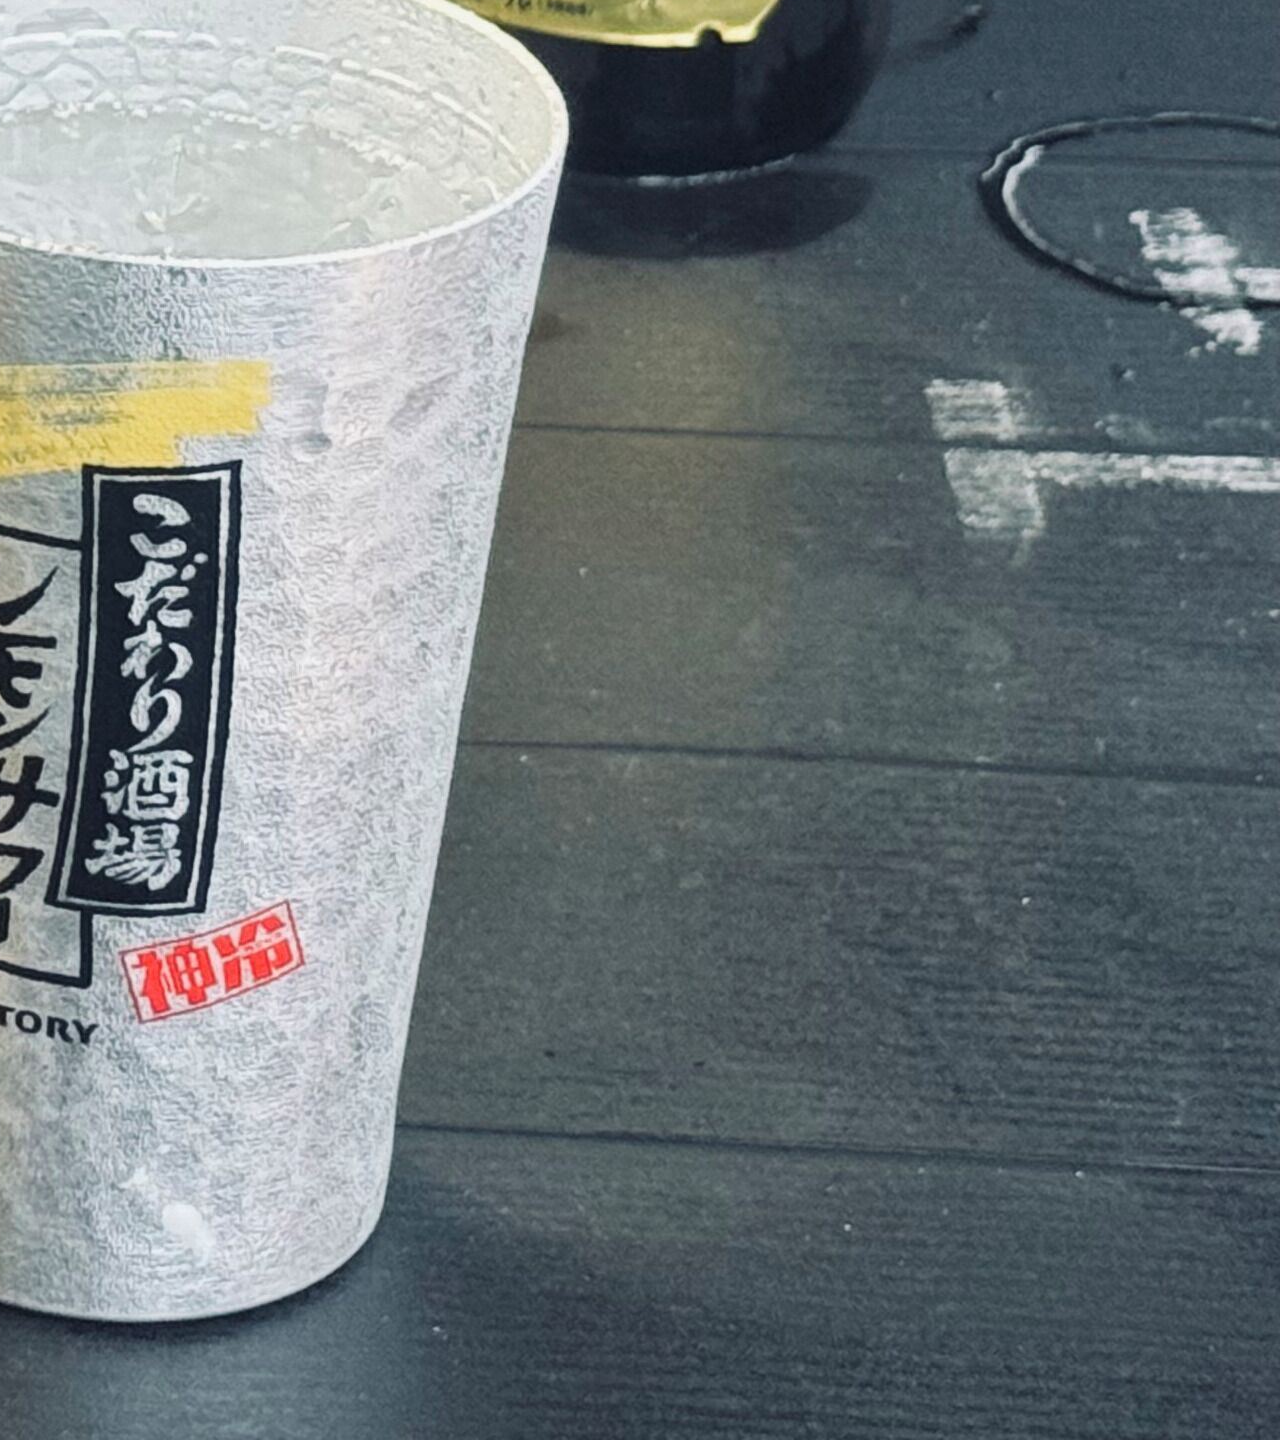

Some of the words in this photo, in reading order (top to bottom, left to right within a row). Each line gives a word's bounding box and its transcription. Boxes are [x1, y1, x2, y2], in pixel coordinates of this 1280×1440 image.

[84, 492, 210, 893] こだわり酒場
